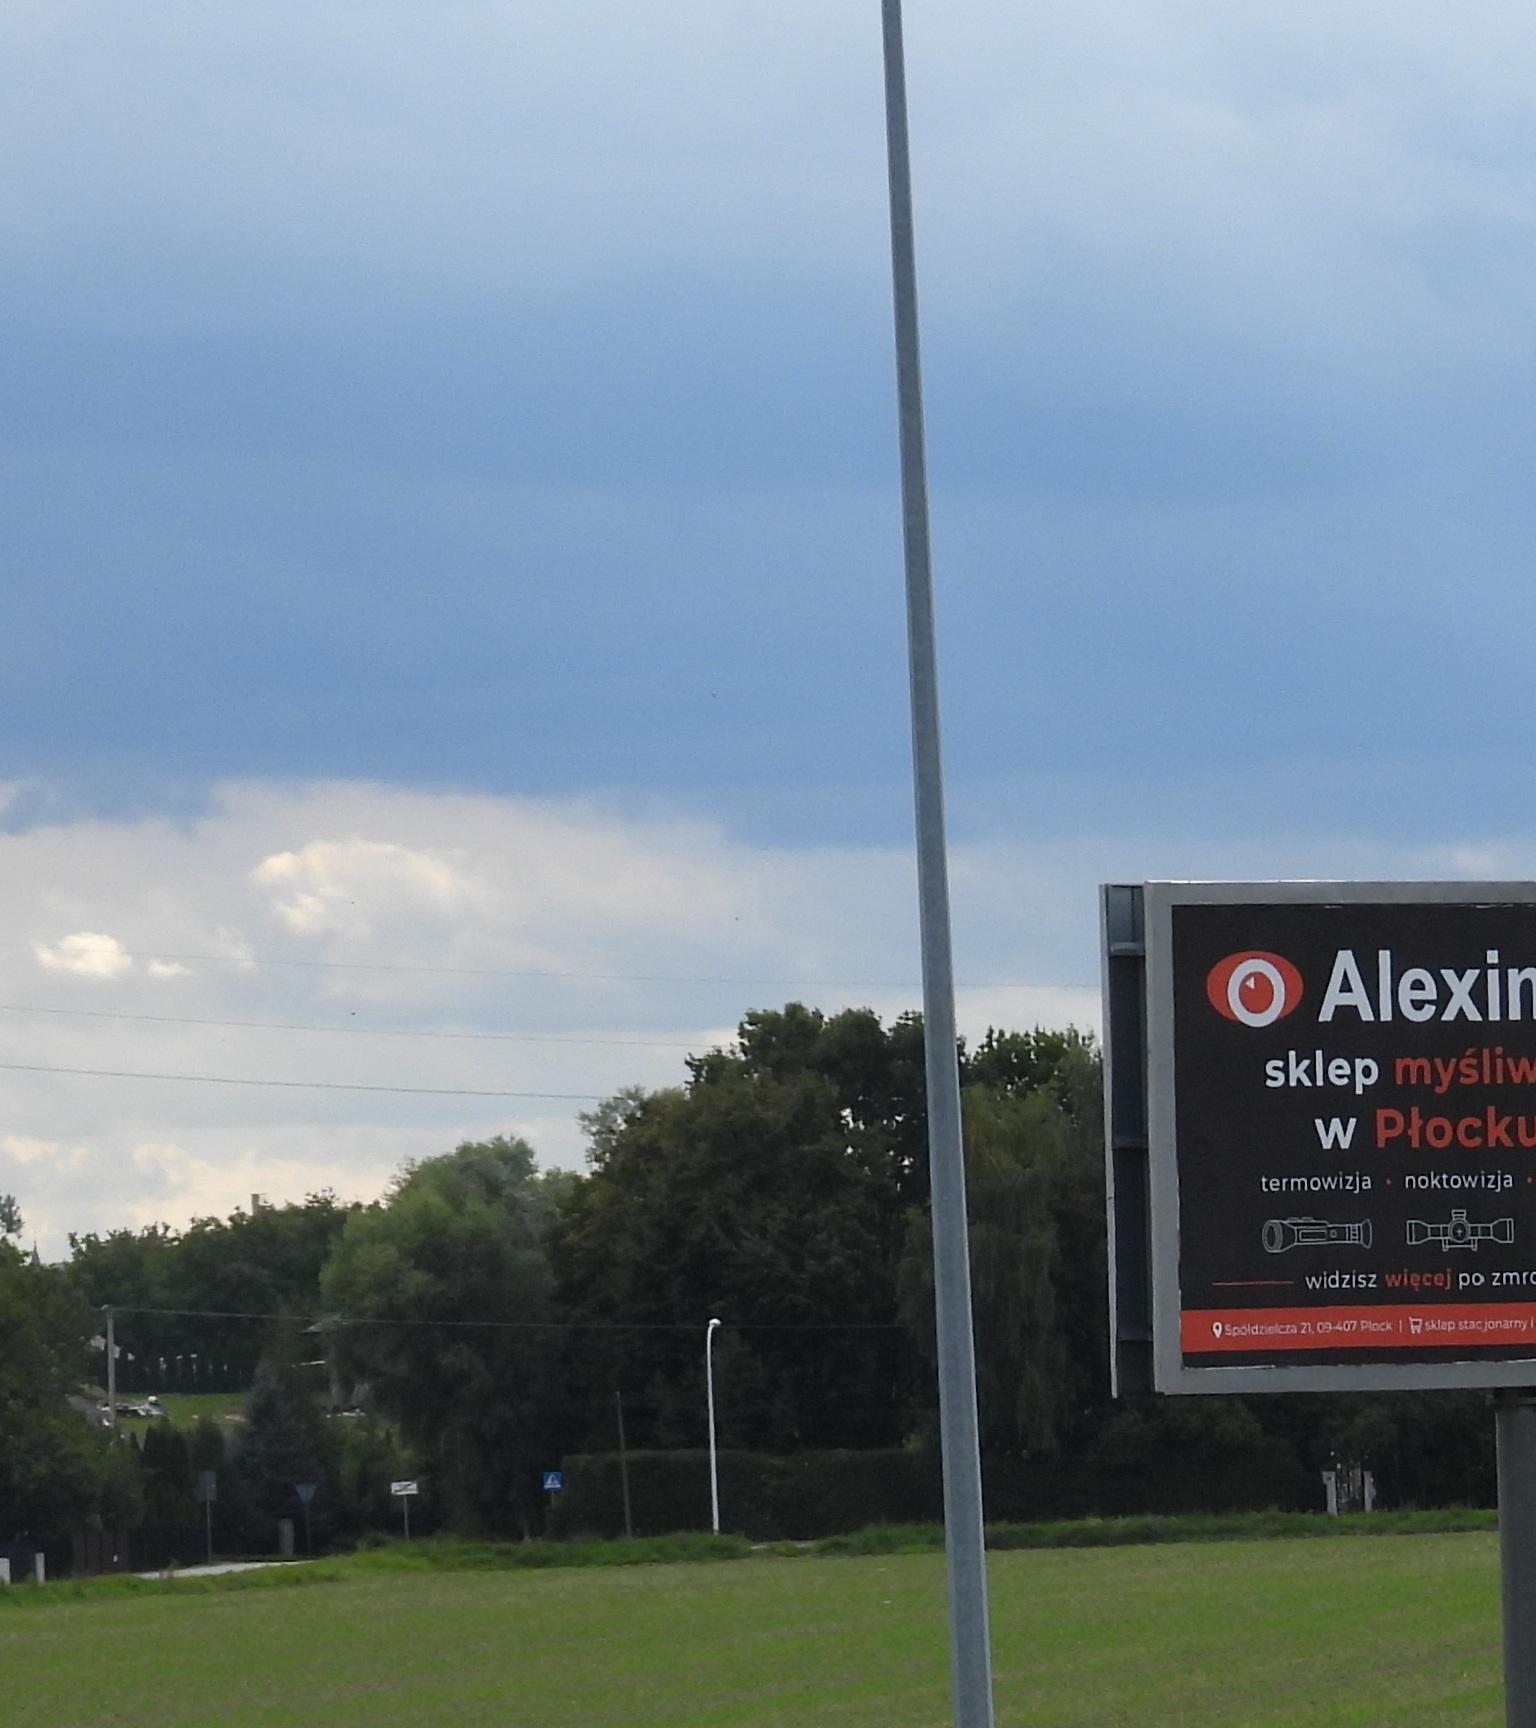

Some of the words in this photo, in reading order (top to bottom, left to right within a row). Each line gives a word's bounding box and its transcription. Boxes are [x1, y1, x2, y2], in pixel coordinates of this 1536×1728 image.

[1265, 1049, 1379, 1095] sklep
[1314, 1117, 1357, 1150] w
[1261, 1171, 1373, 1194] termowizja
[1405, 1170, 1514, 1193] noktowizja
[1305, 1269, 1378, 1289] widzisz
[1385, 1268, 1452, 1291] więcej
[1458, 1270, 1485, 1289] po
[1317, 1320, 1357, 1333] 09-407
[1425, 1318, 1456, 1333] sklep
[1458, 1316, 1528, 1333] stacjonarny
